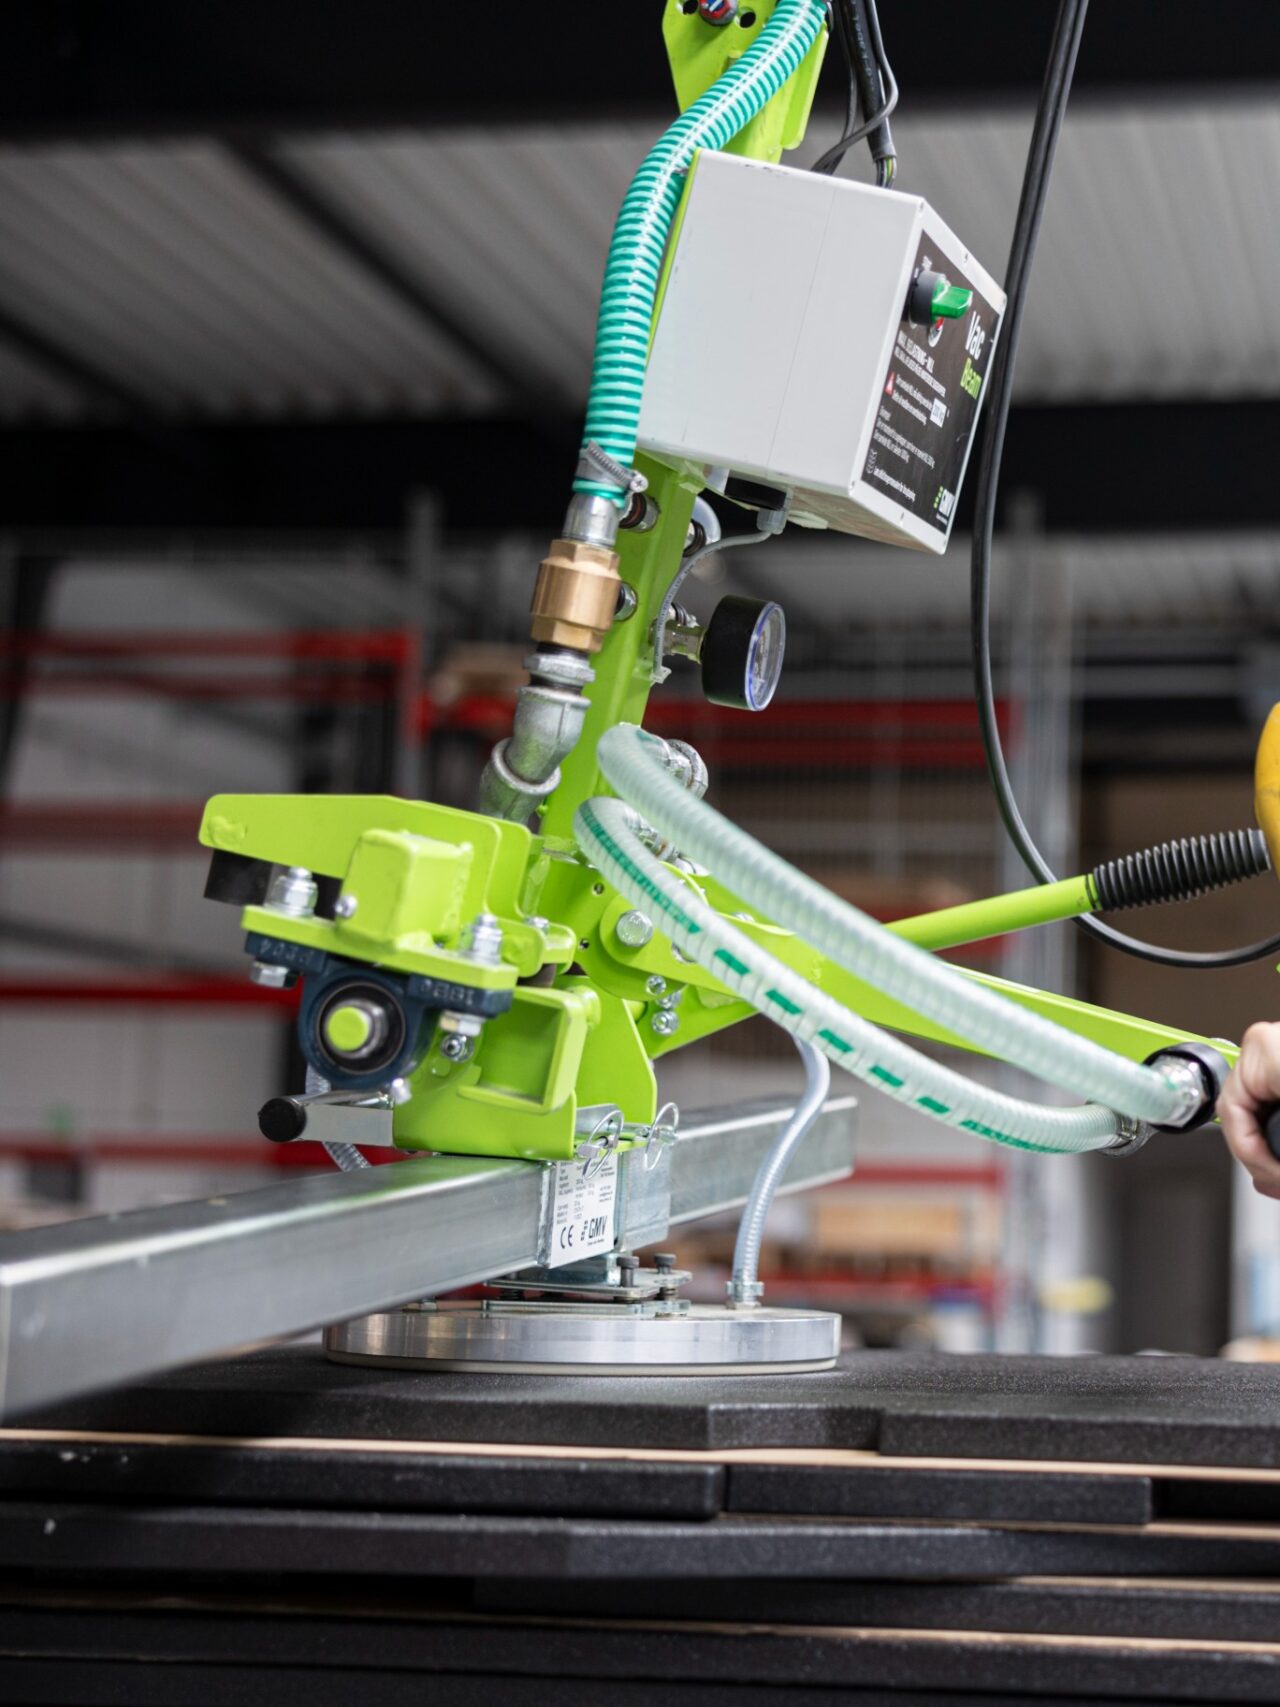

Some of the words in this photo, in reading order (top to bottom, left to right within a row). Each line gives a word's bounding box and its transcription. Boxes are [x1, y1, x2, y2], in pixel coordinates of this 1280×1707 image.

[965, 310, 985, 361] Vac
[960, 357, 982, 400] Beam
[588, 1215, 608, 1239] GMV
